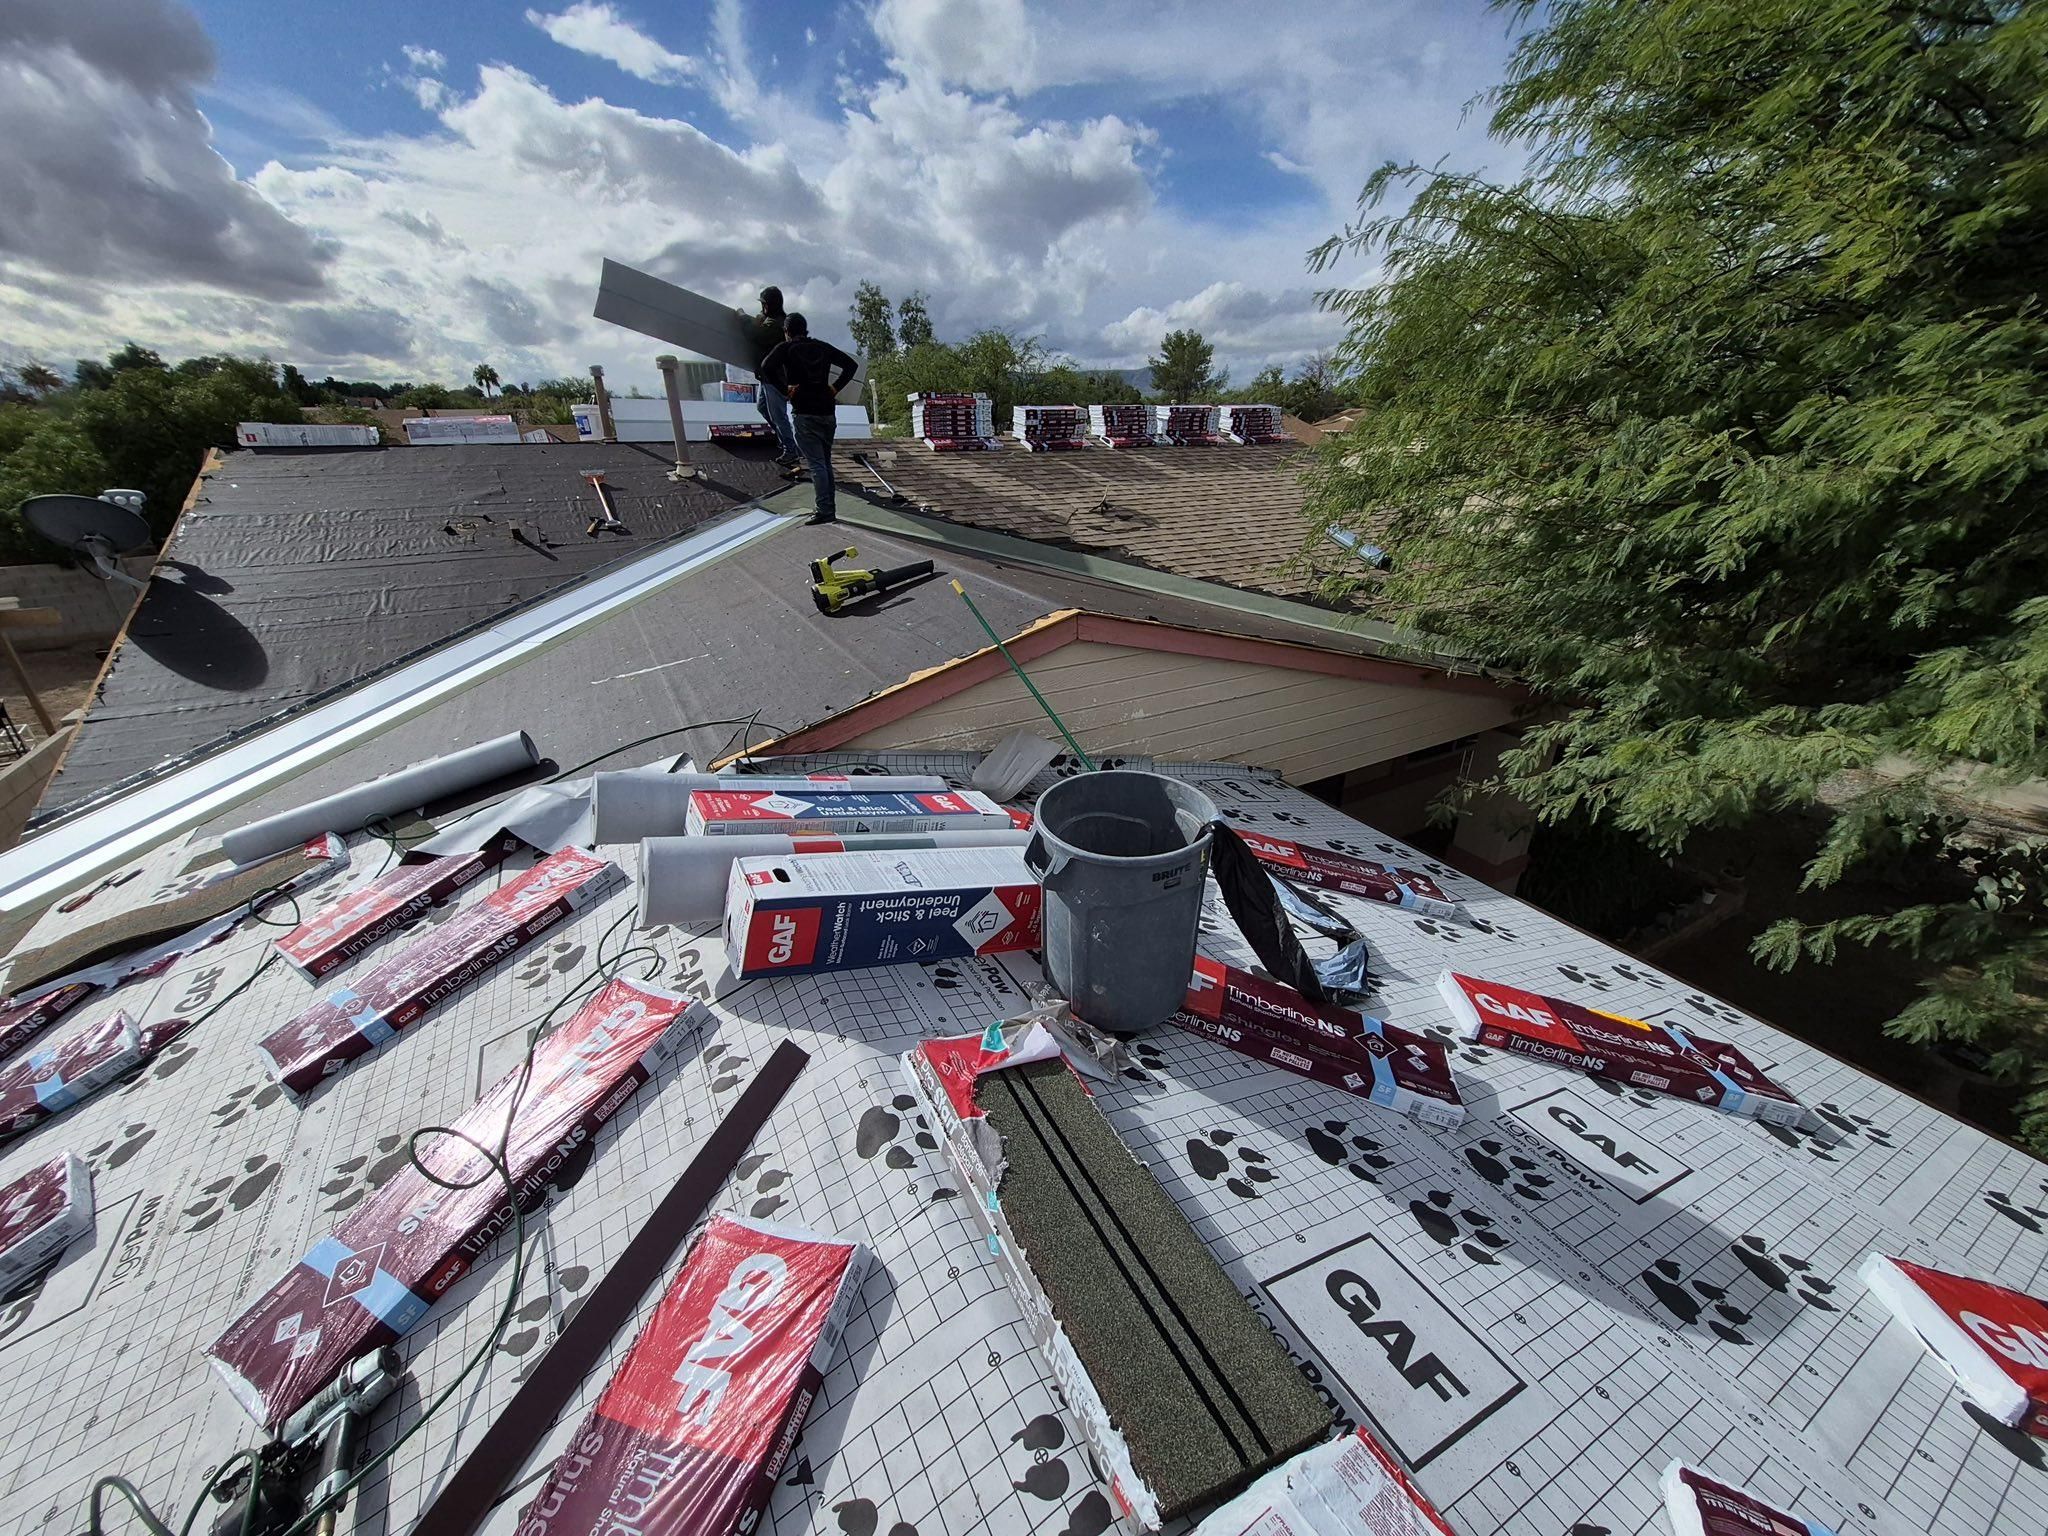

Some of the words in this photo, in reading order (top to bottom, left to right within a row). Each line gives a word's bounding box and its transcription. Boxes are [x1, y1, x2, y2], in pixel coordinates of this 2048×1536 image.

[931, 794, 961, 811] GAF
[1224, 781, 1262, 800] GAF
[1244, 838, 1295, 857] GAF
[749, 872, 764, 886] GAF
[1152, 863, 1191, 882] BRUTE
[859, 895, 961, 912] Underlayment
[917, 908, 925, 920] &
[929, 907, 958, 918] Peel
[876, 910, 911, 923] Stick
[768, 914, 797, 964] GAF
[320, 957, 342, 973] GAF
[174, 966, 226, 1013] GAF
[982, 984, 1006, 1012] Protection
[398, 1006, 419, 1024] GAF
[1474, 993, 1556, 1028] GAF
[1224, 1012, 1301, 1046] Shingles
[1485, 1031, 1505, 1043] GAF
[606, 1096, 616, 1106] NOT
[617, 1078, 634, 1095] TRIPLE
[1377, 1084, 1392, 1095] SF
[1548, 1106, 1659, 1176] GAF
[1490, 1119, 1528, 1148] Premium
[1573, 1177, 1622, 1218] Protection
[434, 1260, 462, 1292] GAF
[397, 1304, 418, 1326] SF
[672, 1253, 789, 1427] GAF
[1325, 1269, 1471, 1403] GAF
[790, 1395, 812, 1440] PALLETS
[767, 1456, 778, 1473] DO
[777, 1436, 788, 1454] NOT
[607, 1448, 648, 1505] Natural
